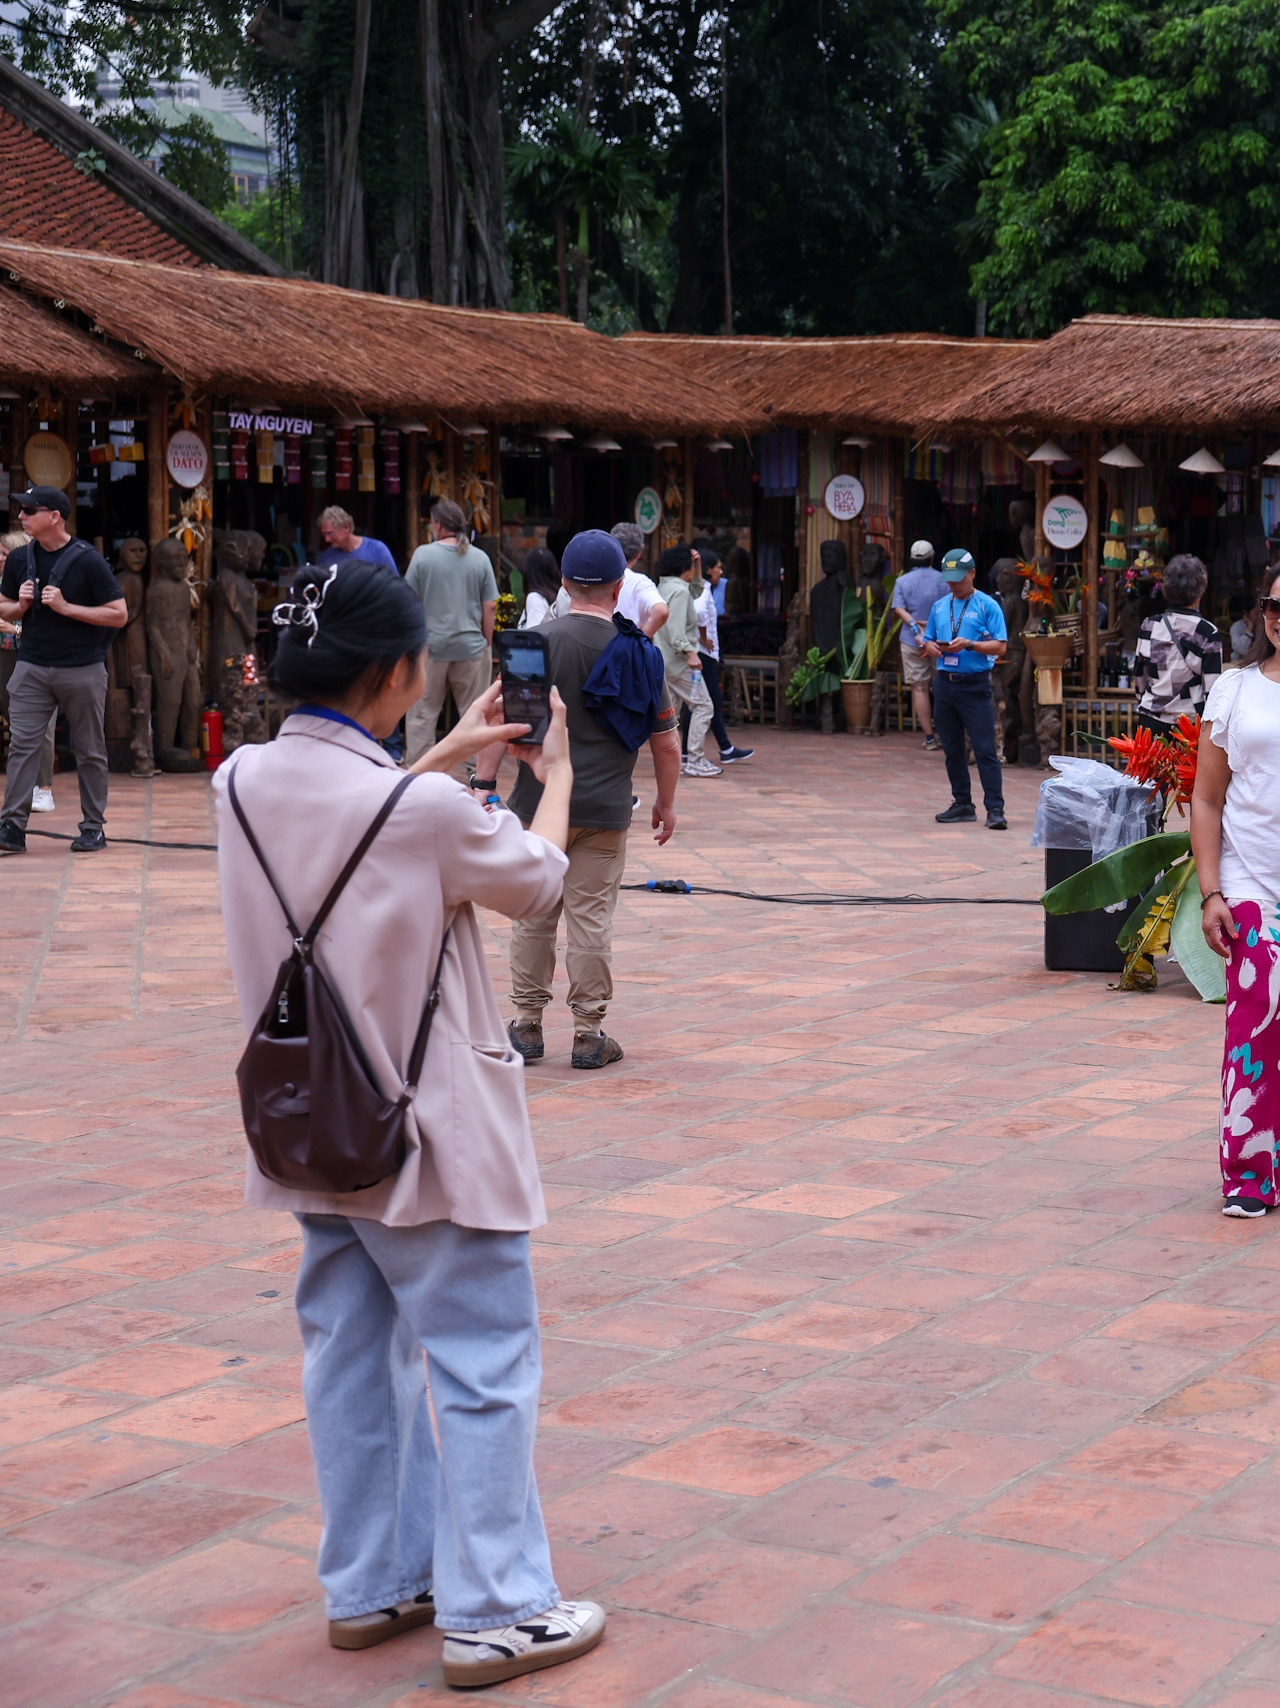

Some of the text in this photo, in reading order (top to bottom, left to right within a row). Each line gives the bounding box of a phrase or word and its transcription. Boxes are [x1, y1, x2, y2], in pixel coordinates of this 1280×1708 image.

[228, 412, 313, 435] TAY NGUYEN
[172, 457, 203, 470] DATO
[834, 490, 855, 501] BYA
